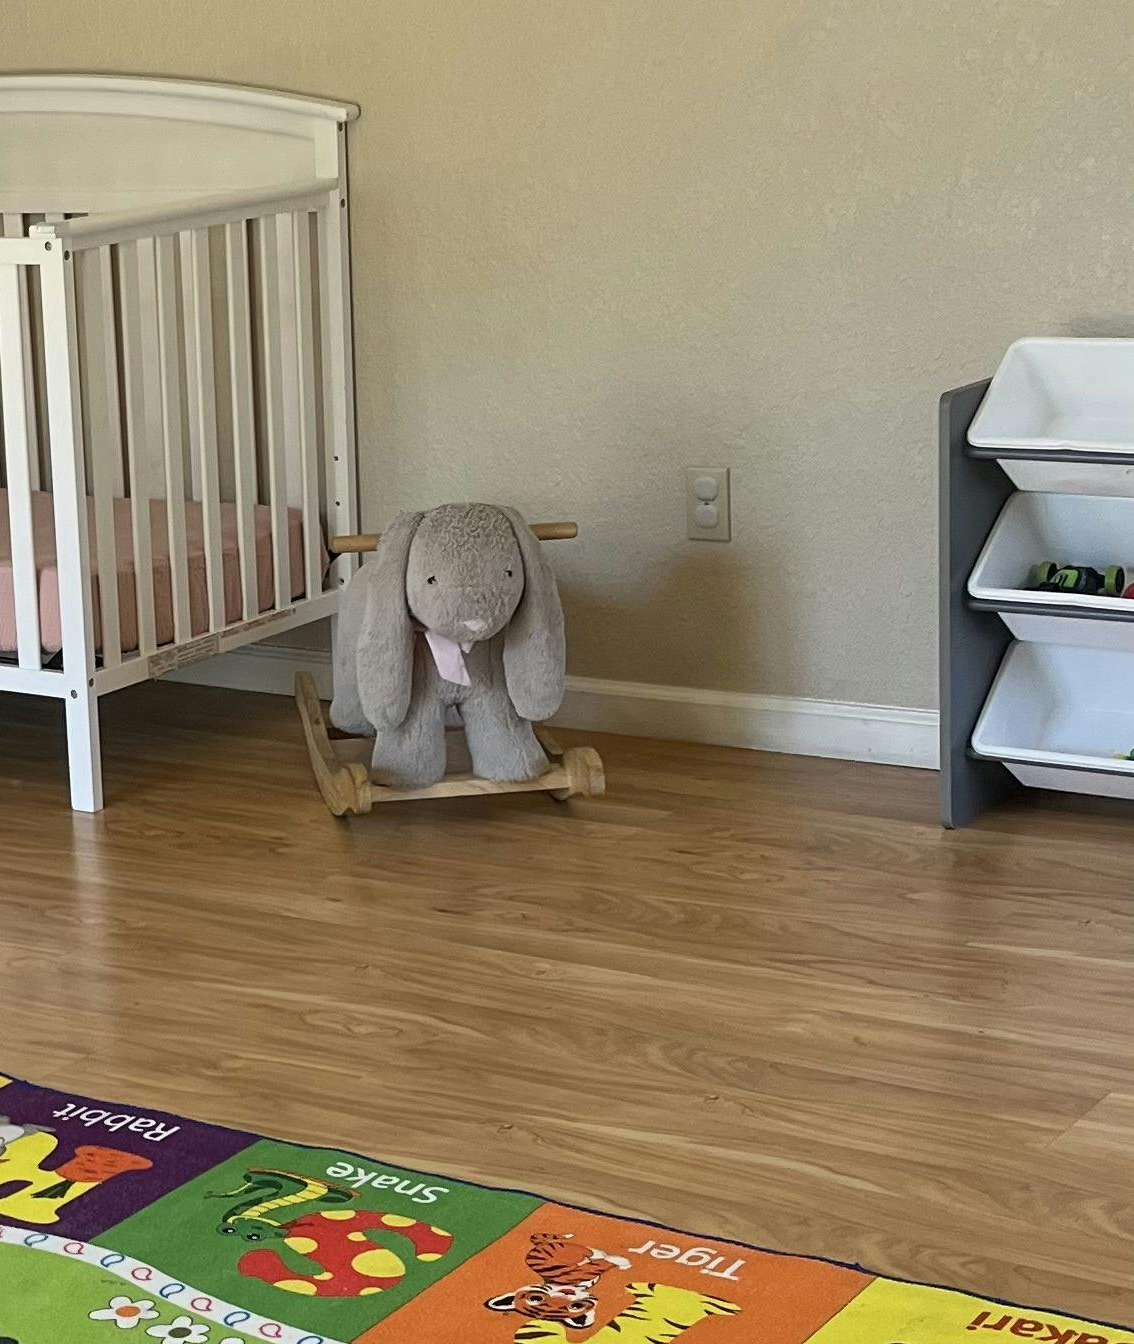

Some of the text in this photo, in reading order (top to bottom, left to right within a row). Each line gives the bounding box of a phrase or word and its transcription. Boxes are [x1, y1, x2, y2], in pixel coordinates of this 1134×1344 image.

[54, 1102, 180, 1144] Rabbit
[325, 1161, 451, 1204] Snake
[626, 1237, 749, 1282] Tiger
